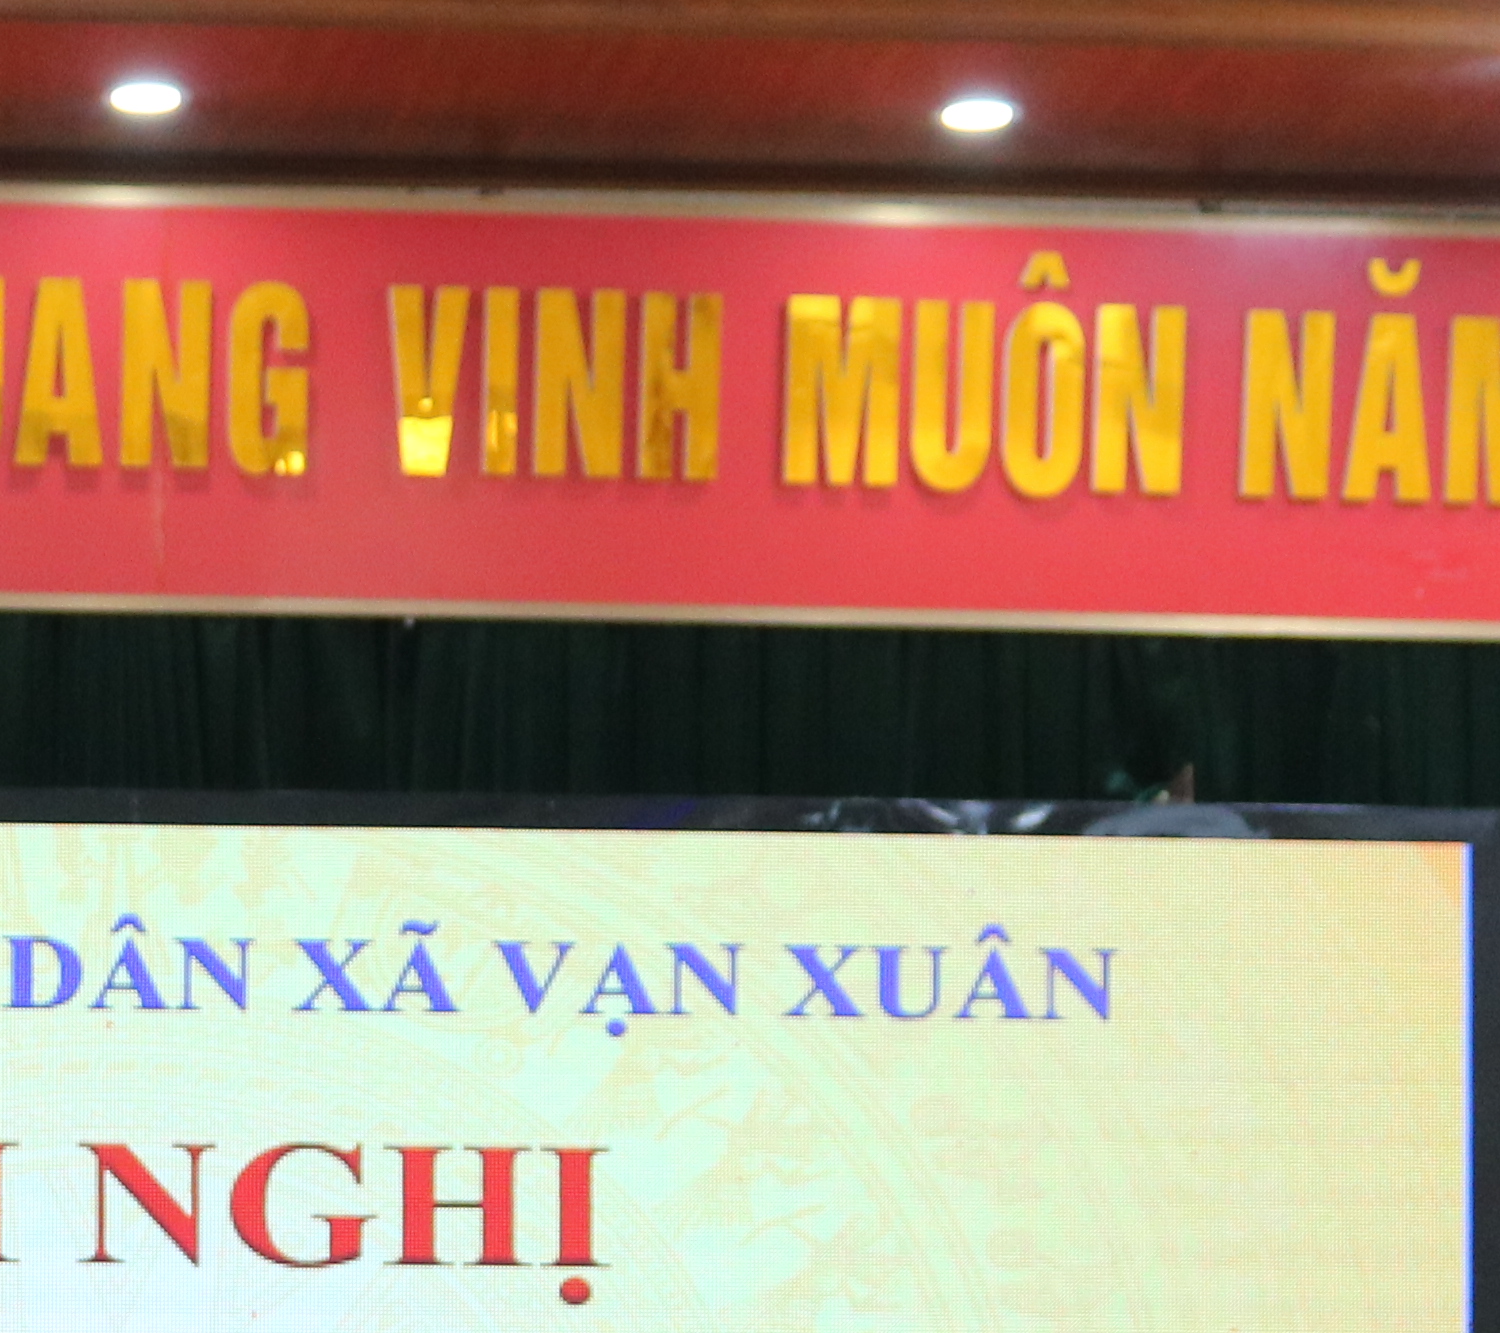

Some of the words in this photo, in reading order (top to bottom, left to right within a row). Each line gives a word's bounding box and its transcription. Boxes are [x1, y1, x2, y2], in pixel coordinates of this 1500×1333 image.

[388, 284, 724, 481] VINH
[783, 251, 1188, 499] MUÔN
[6, 912, 254, 1011] DÂN
[293, 919, 458, 1013] XÃ
[494, 940, 743, 1037] VẠN
[783, 922, 1117, 1021] XUÂN
[79, 1141, 609, 1305] NGHỊ
